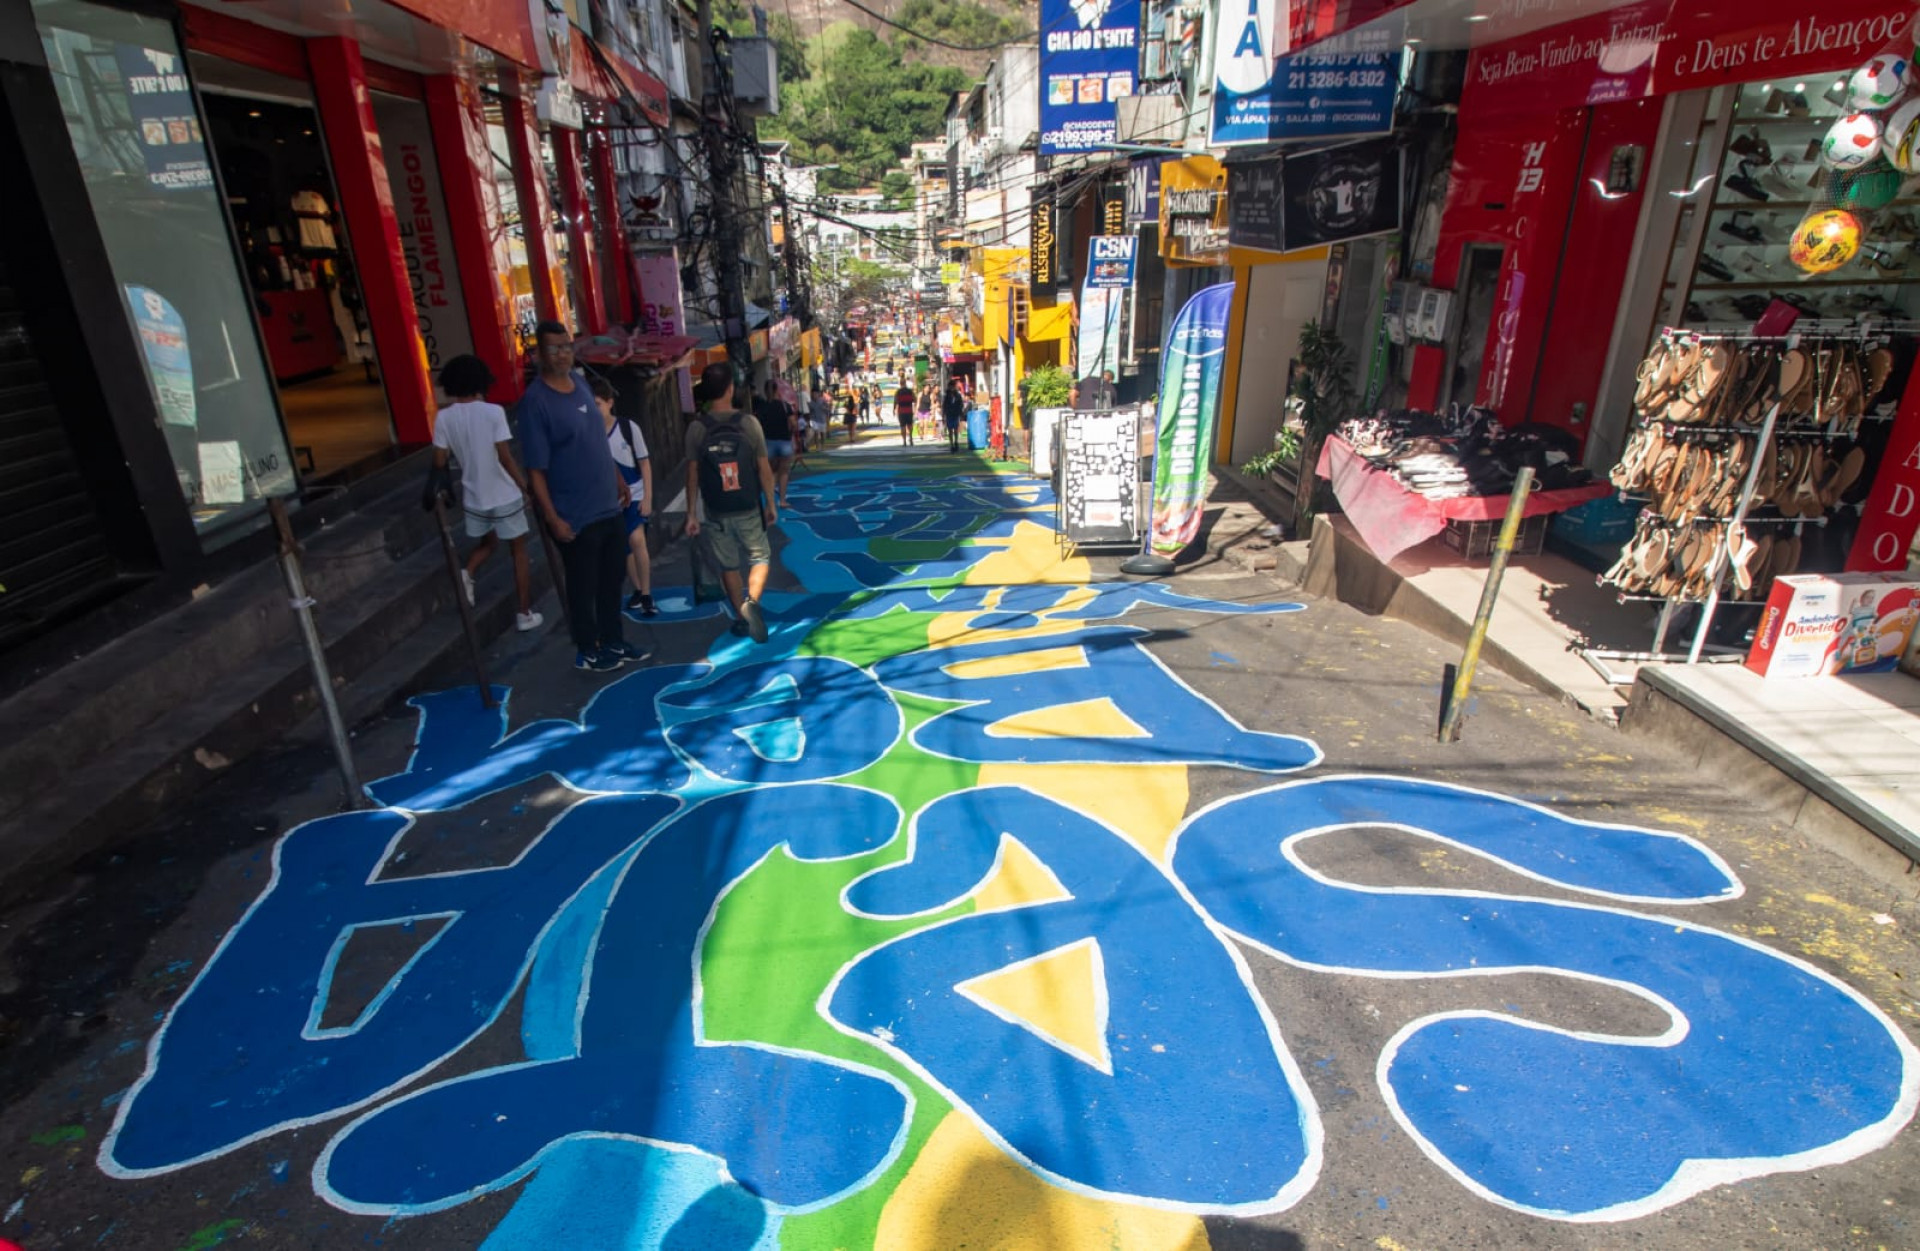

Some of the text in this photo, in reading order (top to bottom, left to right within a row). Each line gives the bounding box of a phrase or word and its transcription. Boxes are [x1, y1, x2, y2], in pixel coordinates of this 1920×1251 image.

[1047, 27, 1135, 52] CIA DO DENTE
[1478, 57, 1502, 86] Seja
[1504, 35, 1582, 78] Bem-Vindo
[1584, 37, 1604, 60] ao
[1674, 11, 1907, 76] e Deus te Abençoe
[1288, 70, 1386, 89] 21 3286-8302
[402, 144, 449, 308] FLAMENGO!
[1095, 237, 1133, 258] CSN
[1170, 362, 1202, 475] DENTISTA
